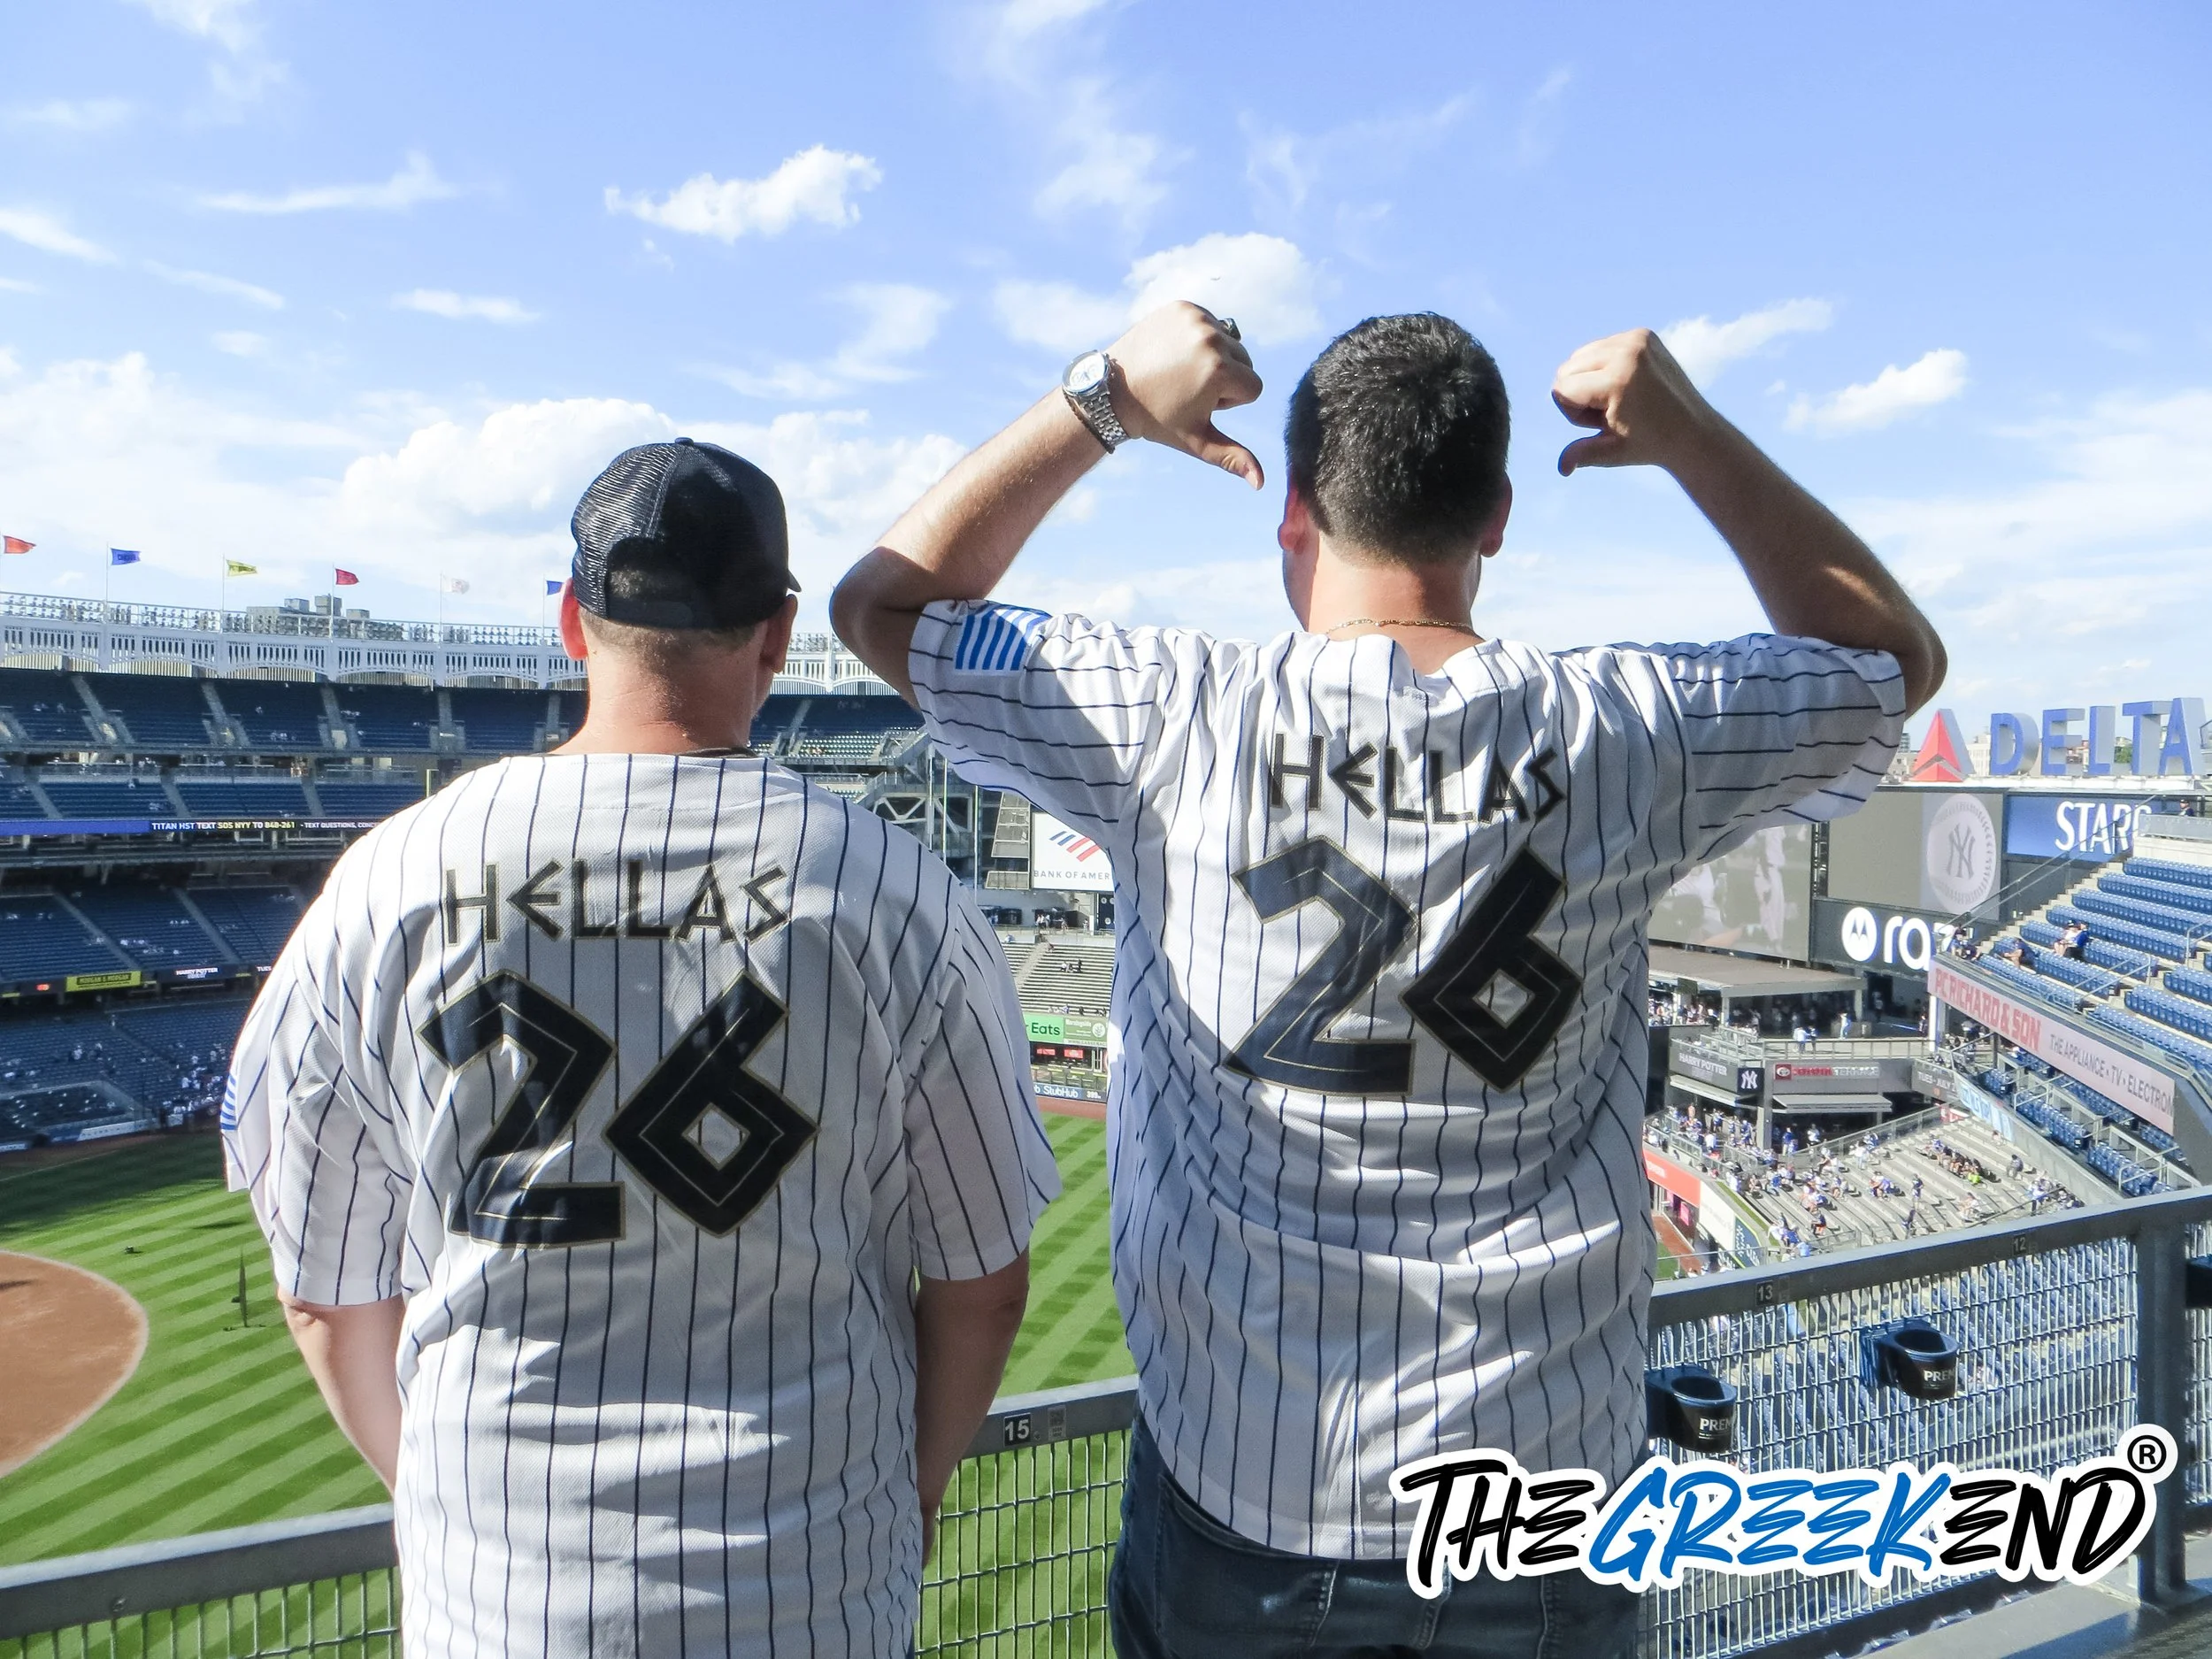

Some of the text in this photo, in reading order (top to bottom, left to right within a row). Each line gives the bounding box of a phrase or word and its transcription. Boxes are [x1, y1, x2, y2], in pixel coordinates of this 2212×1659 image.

[1990, 697, 2204, 775] DELTA
[1271, 732, 1569, 824] HELLAS
[1033, 870, 1062, 879] BANK
[444, 858, 792, 947] HELLAS
[1221, 834, 1585, 1097] 26
[1032, 1022, 1061, 1035] Eats
[1948, 974, 2001, 1027] RICHARD
[2000, 1002, 2010, 1036] &
[2011, 1009, 2041, 1052] SON
[1678, 1052, 1701, 1067] HARRY
[1701, 1059, 1728, 1076] POTTER
[2050, 1033, 2063, 1055] THE
[2063, 1040, 2105, 1078] APPLIANCE
[2111, 1064, 2124, 1086] TV
[414, 969, 822, 1249] 26
[1043, 1086, 1079, 1098] StubHub
[2014, 1237, 2027, 1252] 12
[1758, 1285, 1773, 1301] 13
[1005, 1419, 1030, 1441] 15
